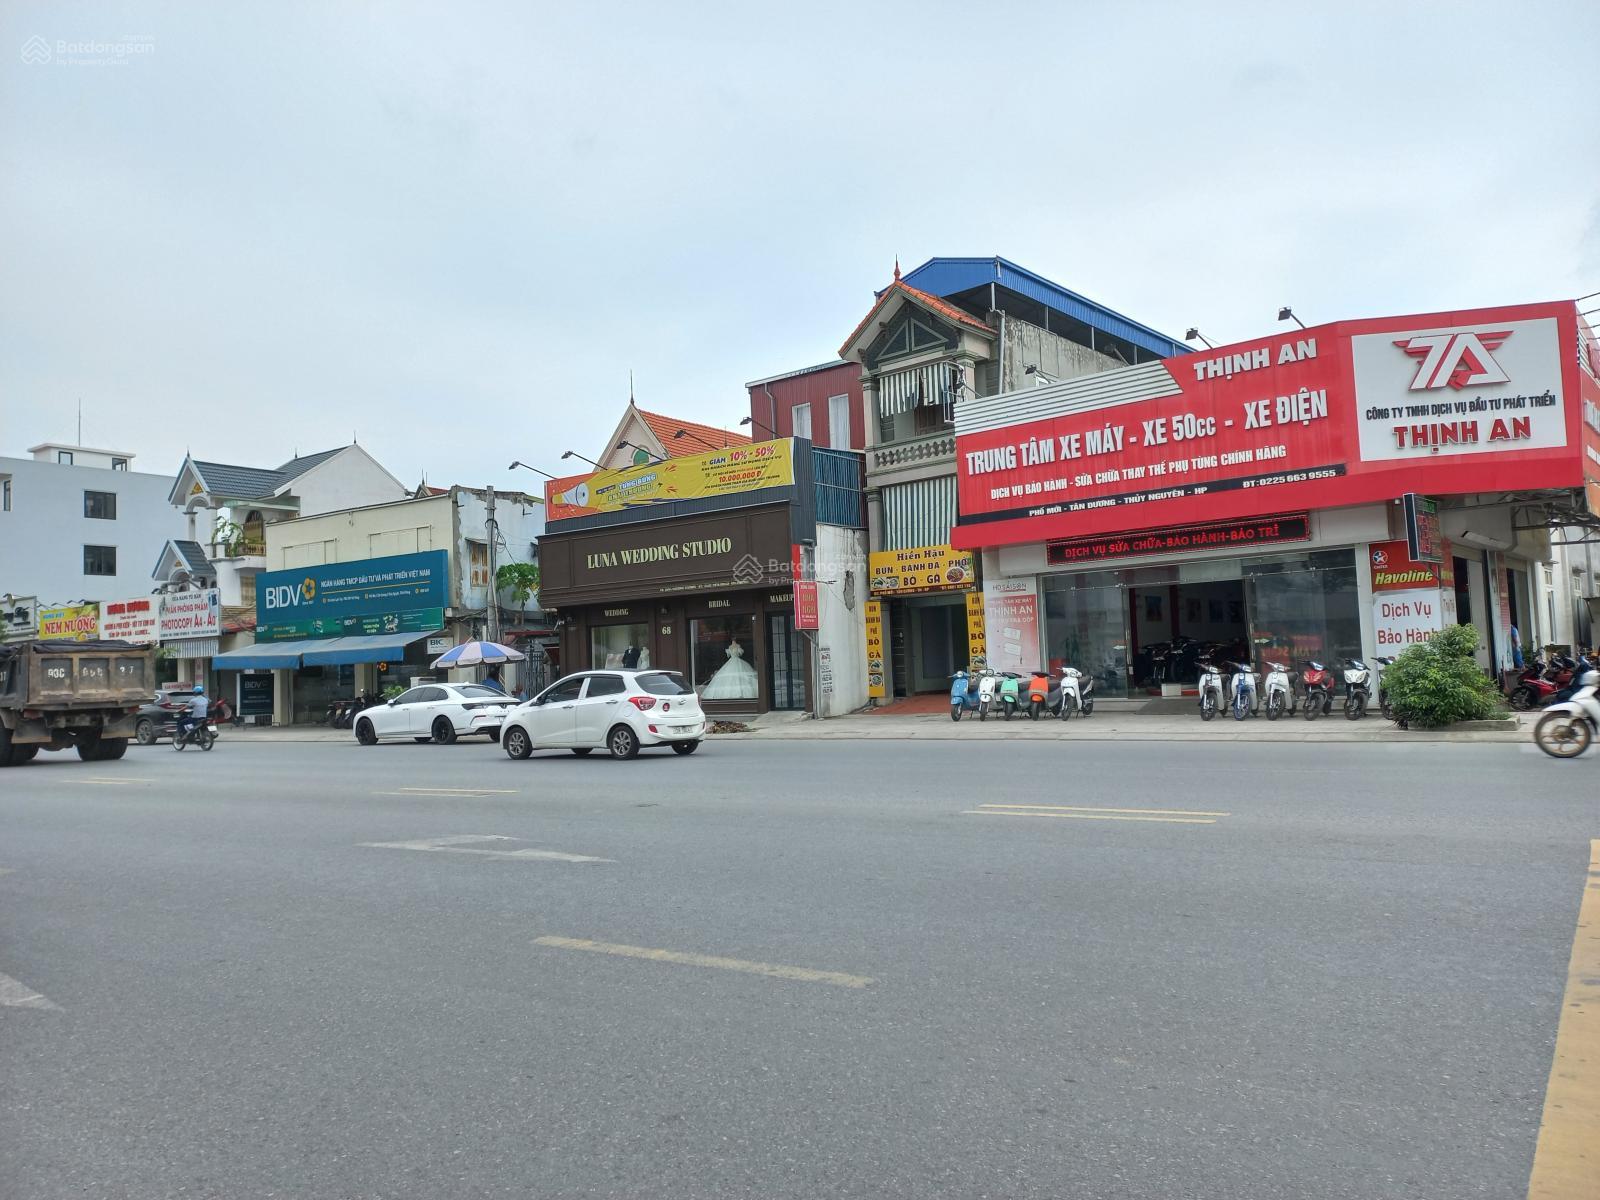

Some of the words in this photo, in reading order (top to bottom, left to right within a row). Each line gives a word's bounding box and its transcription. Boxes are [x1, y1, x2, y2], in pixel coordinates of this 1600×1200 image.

[1194, 350, 1270, 380] THỊNH
[1278, 338, 1317, 364] AN
[1366, 406, 1390, 420] CÔNG
[1391, 407, 1404, 418] TY
[1431, 403, 1452, 417] DỊCH
[1454, 402, 1467, 415] VỤ
[1469, 396, 1488, 412] ĐẦU
[1503, 395, 1527, 410] PHÁT
[1529, 389, 1556, 408] TRIỂN
[966, 446, 1017, 476] TRUNG
[1020, 437, 1056, 467] TÂM
[1059, 434, 1081, 461] XE
[1085, 423, 1124, 456] MÁY
[1143, 418, 1168, 447] XE
[1173, 413, 1217, 442] 50cc
[1244, 400, 1272, 430] XE
[1276, 387, 1328, 427] ĐIỆN
[1393, 421, 1479, 453] THỊNH
[1487, 416, 1532, 442] AN
[729, 450, 748, 462] 10%
[755, 444, 776, 457] 50%
[991, 486, 1010, 501] DỊCH
[1012, 485, 1024, 498] VỤ
[1025, 481, 1042, 495] BẢO
[1044, 478, 1068, 492] HÀNH
[1075, 473, 1093, 487] SỬA
[1096, 469, 1120, 484] CHỮA
[1122, 467, 1146, 480] THAY
[1148, 460, 1166, 476] THẾ
[1169, 459, 1189, 474] PHỤ
[1191, 456, 1218, 470] TÙNG
[1220, 450, 1253, 466] CHÍNH
[1069, 502, 1086, 511] TÂN
[1087, 499, 1116, 509] DƯƠNG
[1194, 486, 1208, 495] HP
[1286, 473, 1307, 483] 663
[1308, 469, 1336, 480] 9555
[587, 551, 618, 569] LUNA
[620, 544, 679, 564] WEDDING
[682, 537, 732, 558] STUDIO
[1092, 544, 1107, 556] VỤ
[419, 568, 431, 577] NAM
[1374, 570, 1434, 586] Havoline
[265, 584, 302, 609] BIDV
[708, 599, 731, 609] BRIDAL
[604, 608, 629, 617] WEDDING
[1019, 605, 1033, 615] AN
[1382, 602, 1410, 621] Dịch
[1414, 601, 1432, 619] Vụ
[44, 621, 62, 634] NEM
[161, 617, 193, 630] PHOTOCOPY
[661, 626, 672, 635] 68
[1377, 629, 1402, 645] Bảo
[868, 650, 881, 659] GÀ
